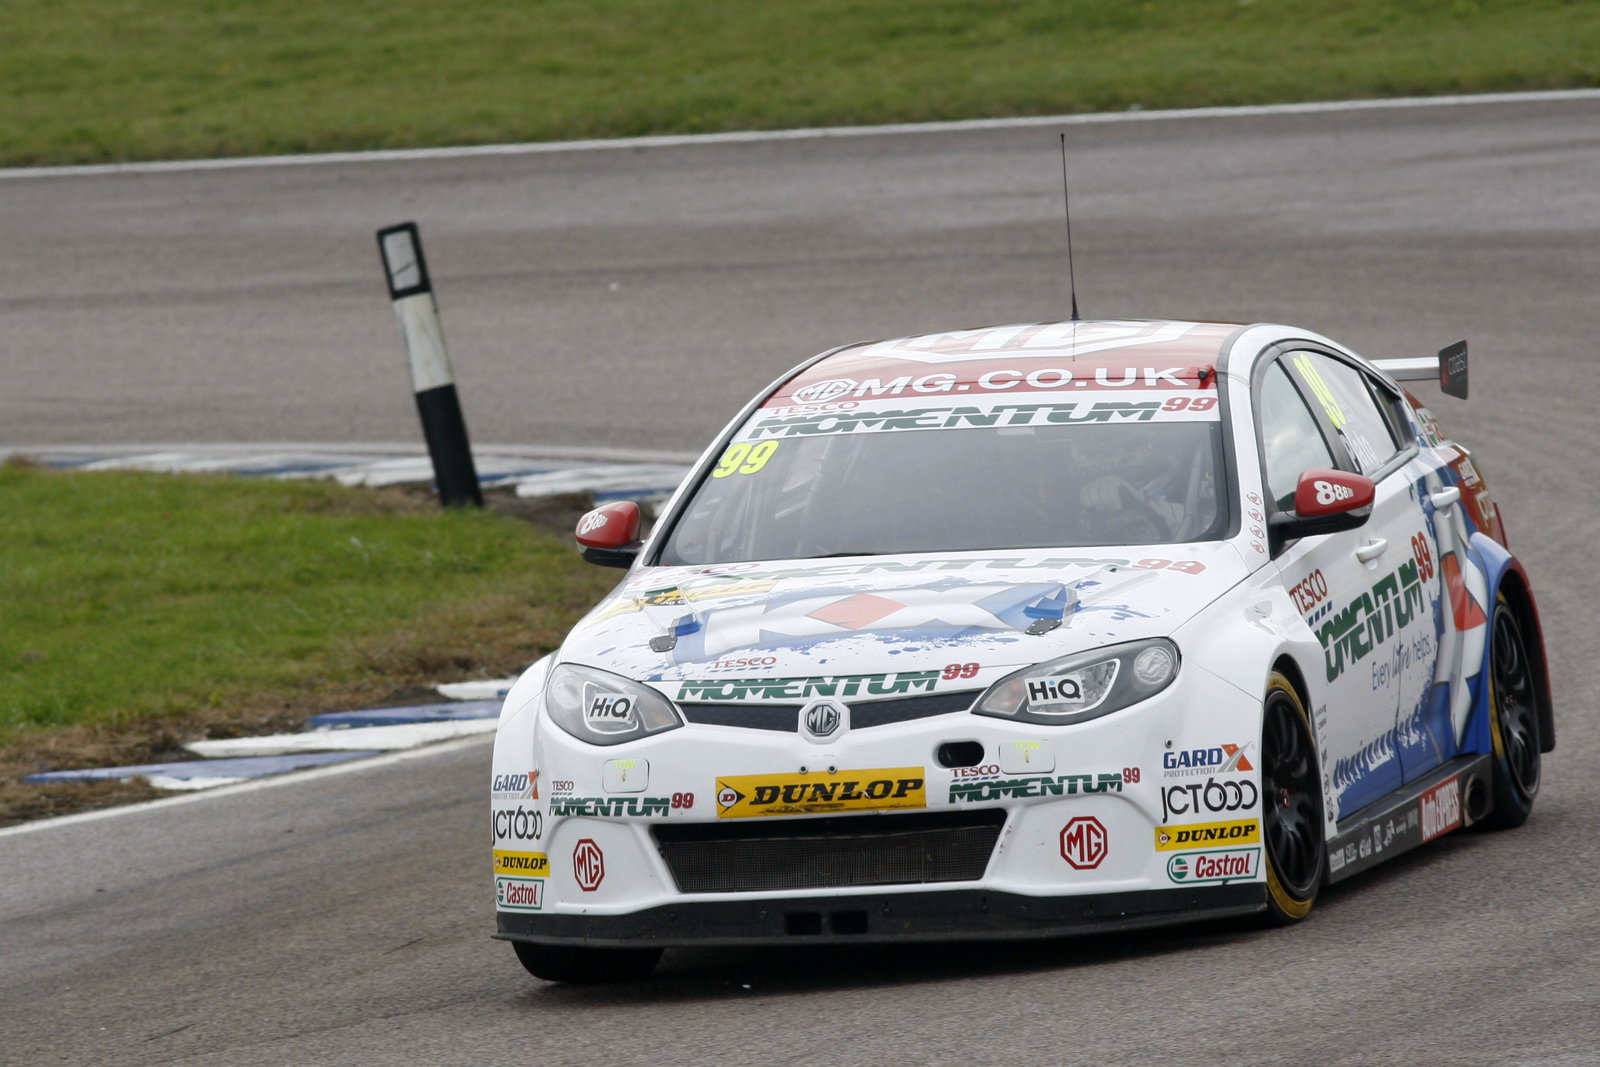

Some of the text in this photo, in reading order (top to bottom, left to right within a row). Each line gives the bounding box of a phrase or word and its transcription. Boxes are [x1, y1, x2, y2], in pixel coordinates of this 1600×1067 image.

[855, 366, 1190, 397] MG.CO.UK
[748, 396, 1218, 439] MOMENTUM 99
[772, 401, 860, 417] TESCO
[713, 441, 779, 478] 99
[1132, 559, 1206, 575] 99
[1412, 531, 1434, 584] 99
[1289, 569, 1328, 615] TESCO
[713, 657, 777, 670] TESCO
[677, 663, 980, 701] MOMENTUM 99
[1029, 679, 1081, 701] HiQ
[590, 697, 631, 720] HiQ
[806, 706, 838, 734] MG
[951, 765, 999, 779] TESCO
[1164, 767, 1216, 778] PROTECTION
[552, 780, 574, 791] TESCO
[749, 778, 923, 807] DUNLOP
[948, 768, 1141, 804] MOMENTUM 99
[549, 792, 694, 817] MOMENTUM 99
[1162, 778, 1258, 824] JCT600
[1065, 822, 1103, 864] MG
[1175, 823, 1256, 843] DUNLOP
[502, 856, 548, 870] DUNLOP
[576, 844, 601, 886] MG
[1195, 853, 1251, 878] Castrol
[507, 881, 538, 905] Castrol
